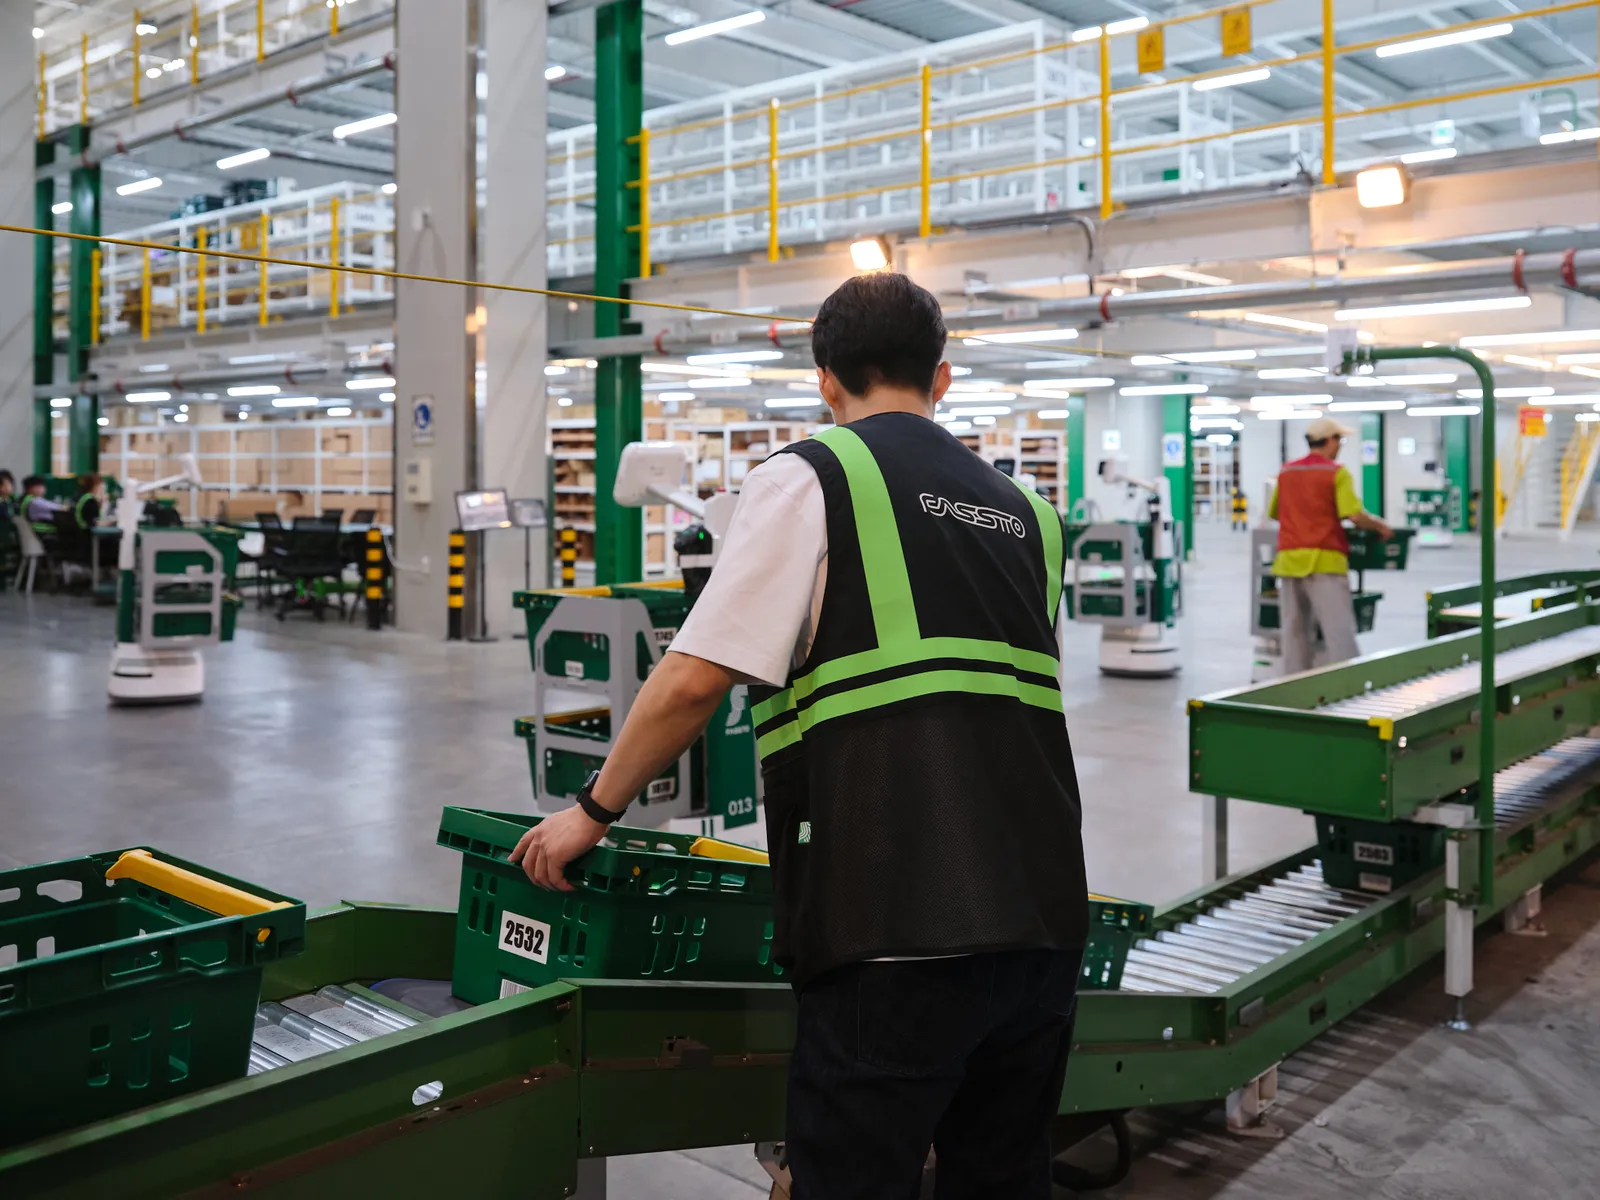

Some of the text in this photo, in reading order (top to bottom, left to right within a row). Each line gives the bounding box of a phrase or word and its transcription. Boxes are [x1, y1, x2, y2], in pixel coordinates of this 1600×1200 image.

[919, 493, 1026, 538] FASSTO
[728, 797, 753, 816] 013
[504, 920, 545, 956] 2532
